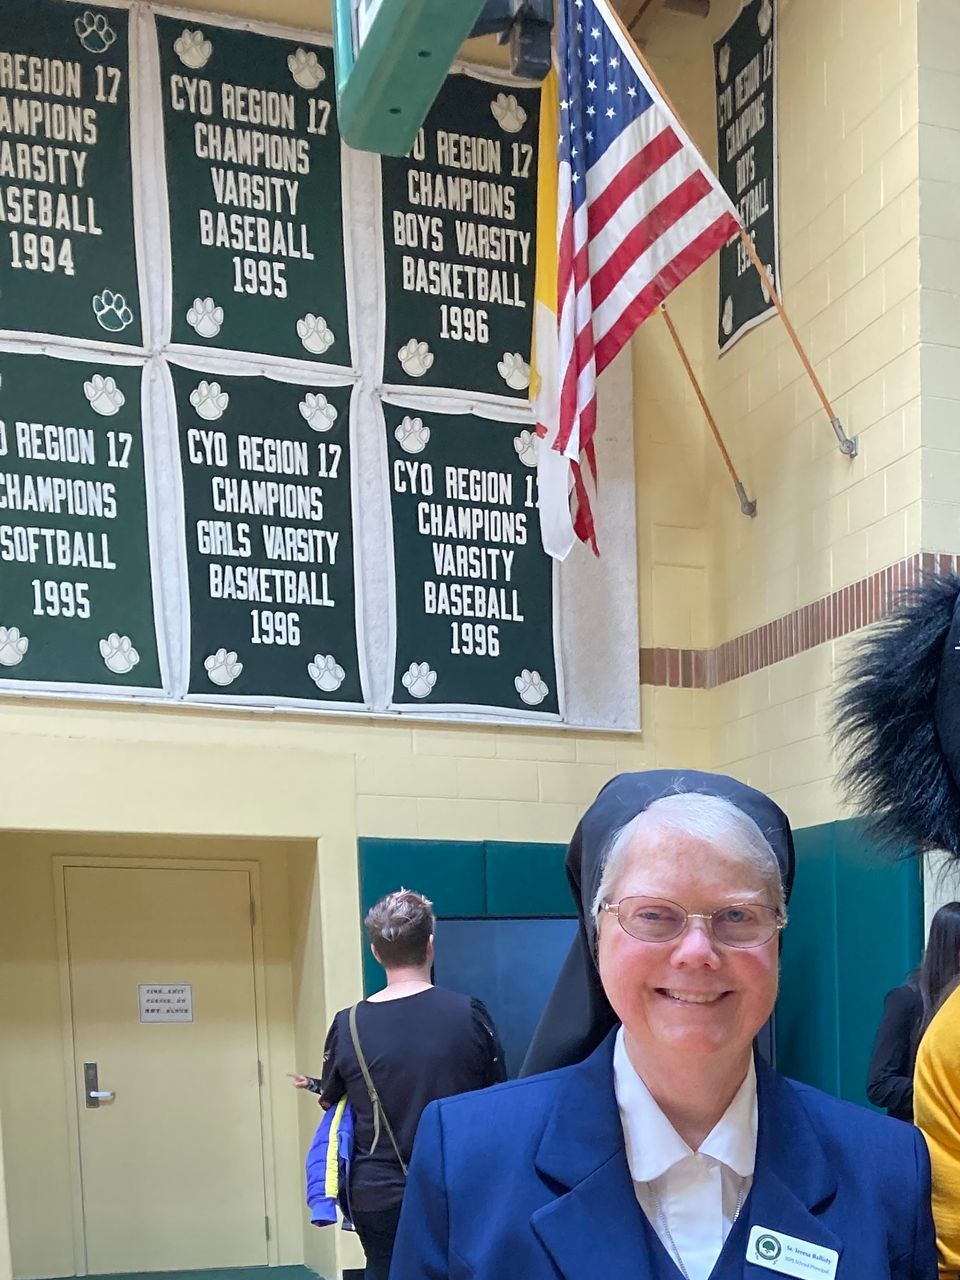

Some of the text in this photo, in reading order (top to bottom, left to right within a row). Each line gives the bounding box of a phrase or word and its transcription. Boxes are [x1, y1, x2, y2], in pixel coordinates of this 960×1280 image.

[0, 52, 121, 103] REGION 17
[0, 96, 97, 145] AMPIONS
[170, 74, 331, 136] CYO REGION 17
[0, 140, 87, 188] ARSITY
[194, 122, 310, 174] CHAMPIONS
[436, 130, 500, 175] REGION
[511, 142, 533, 178] 17
[0, 186, 102, 235] SEBALL
[210, 167, 299, 215] VARSITY
[408, 169, 515, 220] CHAMPIONS
[9, 230, 75, 276] 1994
[199, 209, 314, 260] BASEBALL
[393, 210, 531, 266] BOYS VARSITY
[232, 256, 287, 298] 1995
[402, 255, 526, 308] BASKETBALL
[440, 304, 489, 344] 1996
[16, 422, 95, 465] REGION
[106, 431, 132, 468] 17
[187, 428, 342, 478] CYO REGION 17
[211, 477, 323, 521] CHAMPIONS
[394, 460, 539, 508] CYO REGION 1
[197, 520, 339, 565] GIRLS VARSITY
[418, 502, 527, 545] CHAMPIONS
[0, 525, 116, 570] SOFTBALL
[432, 542, 514, 582] VARSITY
[31, 579, 90, 618] 1995
[209, 564, 335, 607] BASKETBALL
[424, 581, 524, 622] BASEBALL
[250, 610, 300, 646] 1996
[450, 622, 500, 657] 1996
